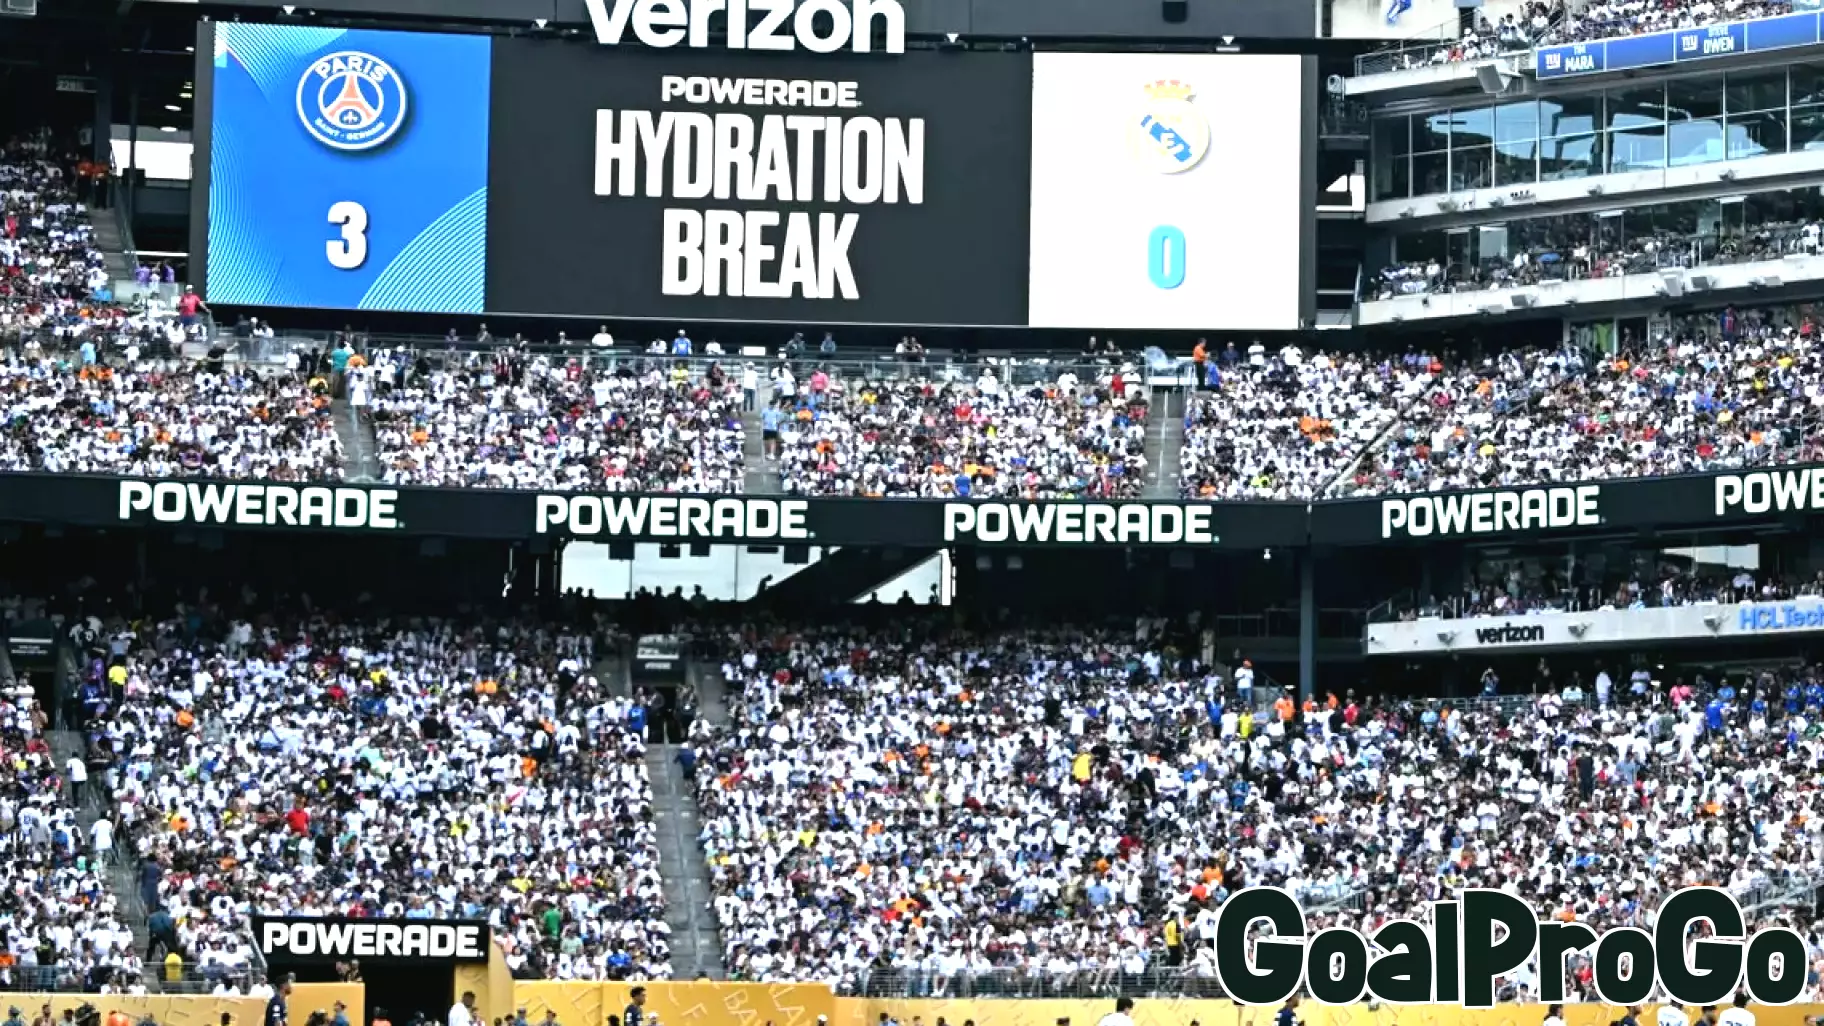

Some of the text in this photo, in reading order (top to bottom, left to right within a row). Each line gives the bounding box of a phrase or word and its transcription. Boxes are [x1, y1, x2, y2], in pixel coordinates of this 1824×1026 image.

[585, 0, 905, 54] verizon
[314, 55, 388, 82] PARIS
[594, 108, 925, 204] HYDRATION
[326, 201, 367, 268] 3
[661, 209, 860, 300] BREAK
[1148, 226, 1187, 290] 0
[1476, 622, 1545, 644] verizon
